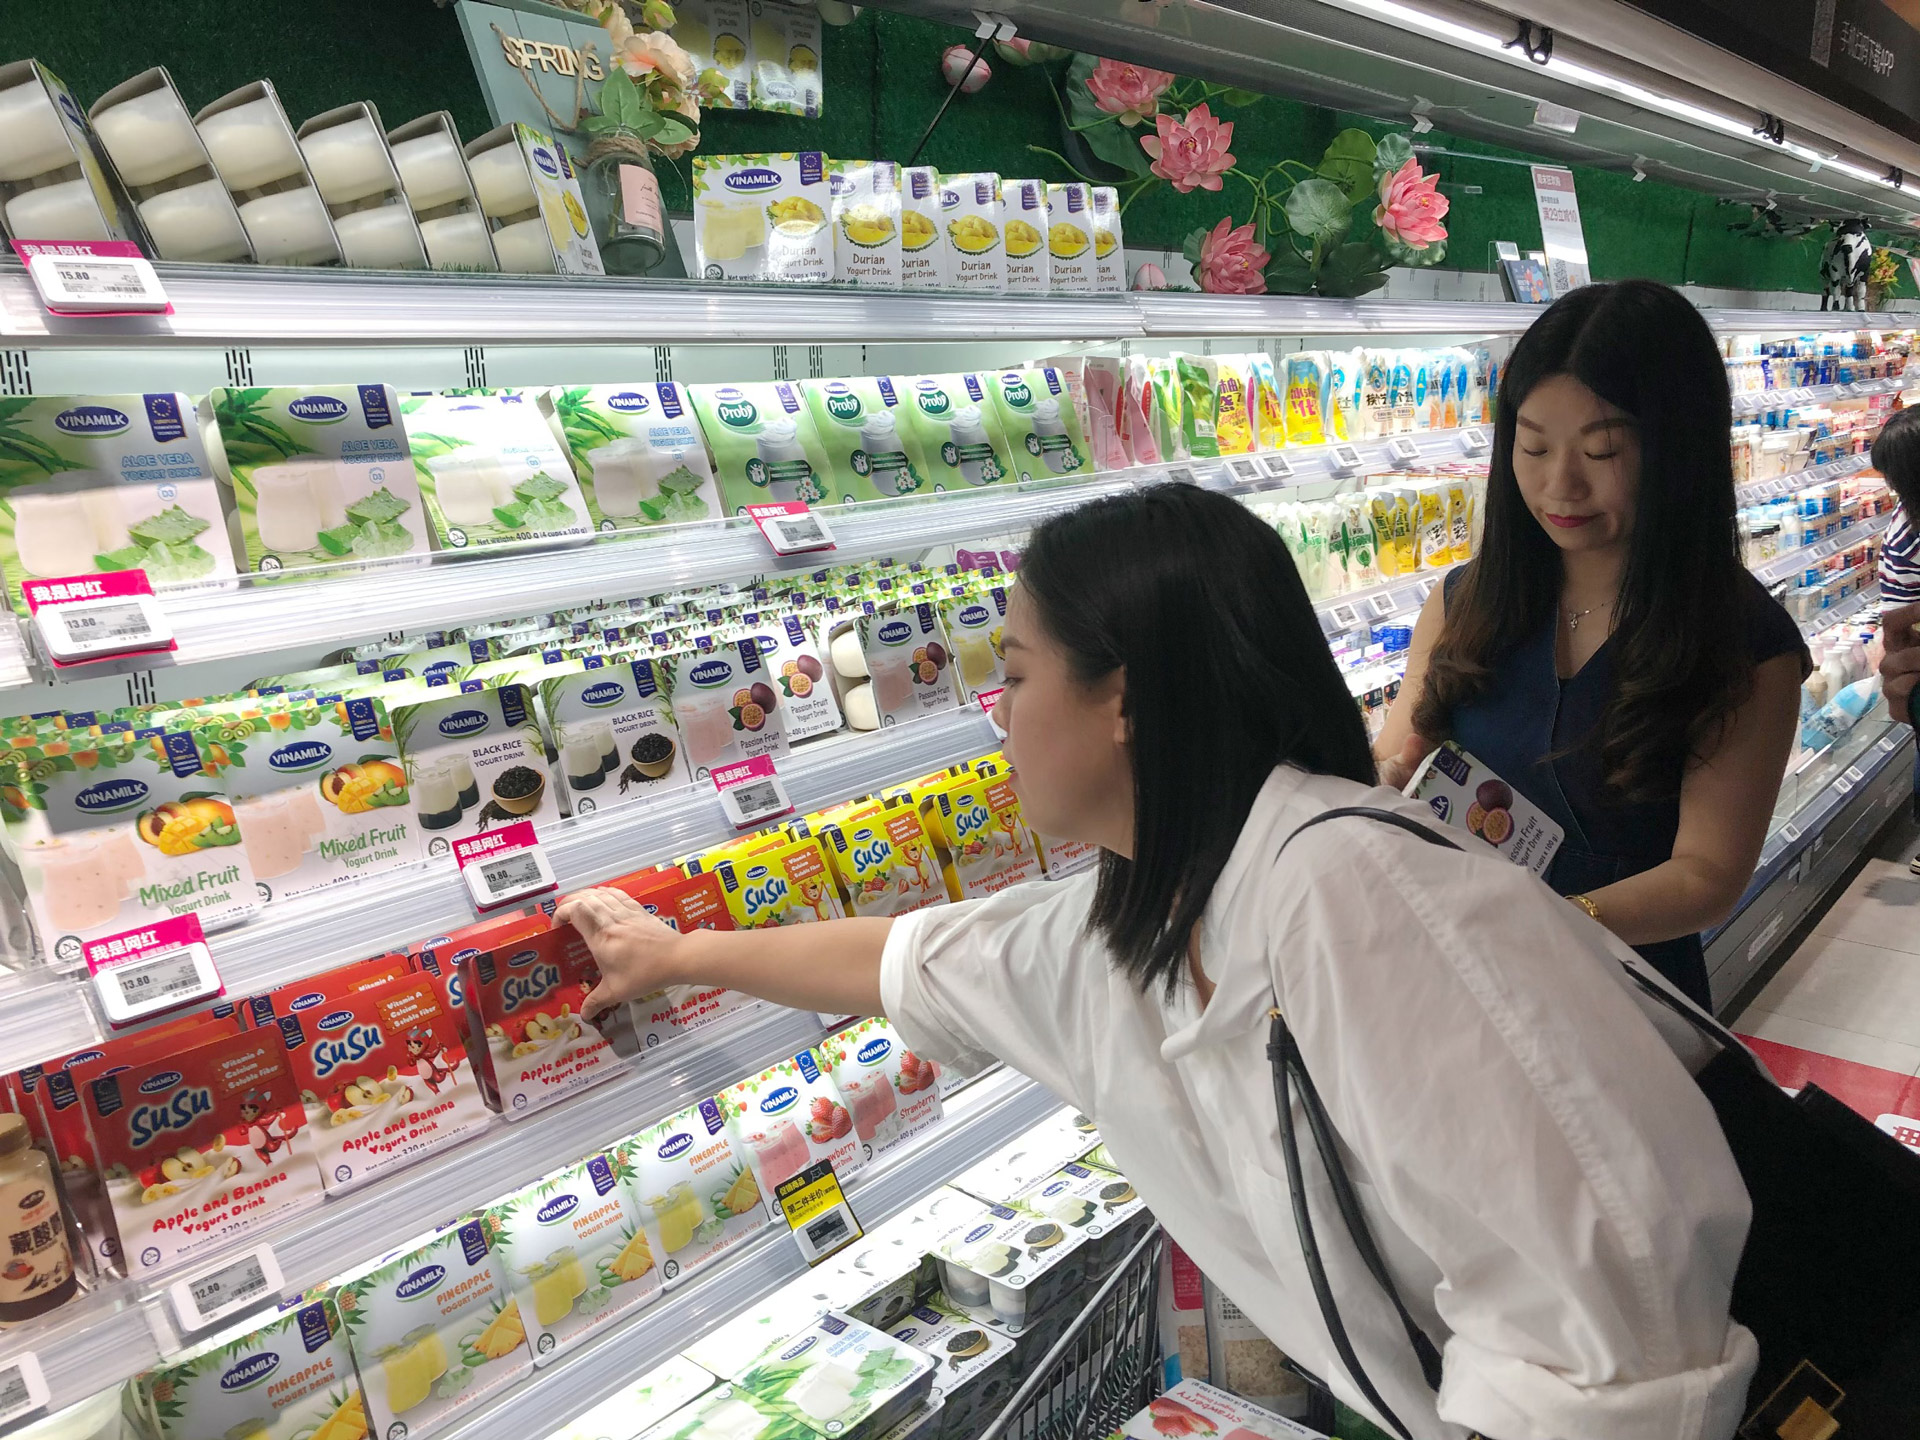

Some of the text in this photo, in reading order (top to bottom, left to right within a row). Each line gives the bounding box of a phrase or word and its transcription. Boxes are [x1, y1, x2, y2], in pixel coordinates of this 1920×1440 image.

[502, 37, 605, 81] SPRING
[728, 173, 780, 185] VINAMILK
[782, 246, 816, 256] Durian
[852, 254, 885, 266] Durian
[776, 257, 824, 268] Yogurt Drink
[846, 266, 892, 278] Yogurt Drink
[961, 261, 991, 271] Durian
[1054, 265, 1082, 275] Durian
[60, 271, 90, 281] 15.80
[956, 272, 998, 282] Yogurt Drink
[1050, 276, 1088, 285] Yogurt Drink
[609, 397, 648, 408] VINAMILK
[919, 394, 947, 409] Proby
[1004, 385, 1031, 401] Proby
[291, 403, 346, 415] VINAMILK
[719, 404, 754, 421] Proby
[829, 397, 857, 413] Proby
[59, 415, 125, 427] VINAMILK
[341, 439, 399, 452] ALOE VERA
[121, 453, 194, 468] ALOE VERA
[341, 452, 404, 465] YOGURT DRINK
[121, 467, 201, 481] YOGURT DRINK
[476, 538, 489, 546] Net
[516, 531, 532, 542] 400
[31, 581, 106, 602] 我是网红
[66, 617, 96, 629] 13.80
[960, 610, 988, 622] VINAMILK
[880, 626, 911, 639] VINAMILK
[692, 664, 730, 681] VINAMILK
[583, 685, 623, 701] VINAMILK
[791, 698, 828, 714] Passion Fruit
[796, 709, 828, 722] Yogurt Drink
[442, 712, 487, 731] VINAMILK
[612, 708, 655, 726] BLACK RICE
[614, 719, 658, 734] YOGURT DRINK
[472, 739, 522, 758] BLACK RICE
[740, 731, 780, 749] Passion Fruit
[272, 745, 330, 765] VINAMILK
[474, 751, 525, 768] YOGURT DRINK
[715, 765, 753, 784] 我是网红
[79, 783, 146, 806] VINAMILK
[956, 806, 990, 837] SuSu
[319, 823, 407, 859] Mixed Fruit
[457, 834, 507, 858] 我是网红
[343, 847, 398, 869] Yogurt Drink
[853, 840, 891, 873] SuSu
[486, 870, 509, 883] 19.80
[968, 873, 1003, 889] Strawberry
[1013, 858, 1035, 872] Banana
[985, 871, 1026, 893] Yogurt Drink
[139, 865, 240, 906] Mixed Fruit
[168, 898, 202, 916] Yogurt
[203, 890, 232, 907] Drink
[681, 893, 702, 905] Vitamin
[684, 900, 705, 912] Calcium
[745, 879, 788, 915] SuSu
[687, 902, 718, 920] Soluble Fiber
[90, 930, 160, 962] 我是网红
[122, 975, 151, 991] 13.80
[503, 964, 561, 1012] SuSu
[292, 994, 324, 1010] VINAMILK
[386, 991, 423, 1010] Vitamin A
[319, 1012, 353, 1029] VINAMILK
[390, 1003, 418, 1019] Calcium
[393, 1004, 437, 1028] Soluble Fiber
[670, 1000, 720, 1027] Yogurt Drink
[221, 1048, 265, 1069] Vitamin A
[314, 1026, 383, 1077] SuSu
[520, 1037, 614, 1083] Apple and Banana
[858, 1040, 890, 1062] VINAMILK
[224, 1062, 258, 1079] Calcium
[228, 1065, 278, 1089] Soluble Fiber
[541, 1056, 600, 1085] Yogurt Drink
[142, 1073, 180, 1091] VINAMILK
[762, 1088, 799, 1112] VINAMILK
[899, 1093, 936, 1120] Strawberry
[131, 1088, 211, 1146] SuSu
[908, 1107, 932, 1125] Yogurt Drink
[342, 1100, 455, 1153] Apple and Banana
[368, 1121, 439, 1155] Yogurt Drink
[659, 1134, 693, 1158] VINAMILK
[688, 1138, 729, 1167] PINEAPPLE
[693, 1149, 732, 1175] YOGURT DRINK
[152, 1172, 287, 1233] Apple and Banana
[538, 1195, 579, 1221] VINAMILK
[786, 1187, 824, 1214] 第二件半价
[182, 1195, 266, 1235] Yogurt Drink
[572, 1200, 621, 1231] PINEAPPLE
[577, 1212, 624, 1240] YOGURT DRINK
[397, 1266, 445, 1295] VINAMILK
[436, 1269, 492, 1306] PINEAPPLE
[194, 1282, 221, 1299] 12.80
[440, 1283, 495, 1317] YOGURT DRINK
[222, 1354, 278, 1387] VINAMILK
[267, 1356, 334, 1399] PINEAPPLE
[272, 1371, 336, 1410] YOGURT DRINK
[1176, 1390, 1245, 1424] Strawberry
[1195, 1392, 1236, 1413] Yogurt Drink
